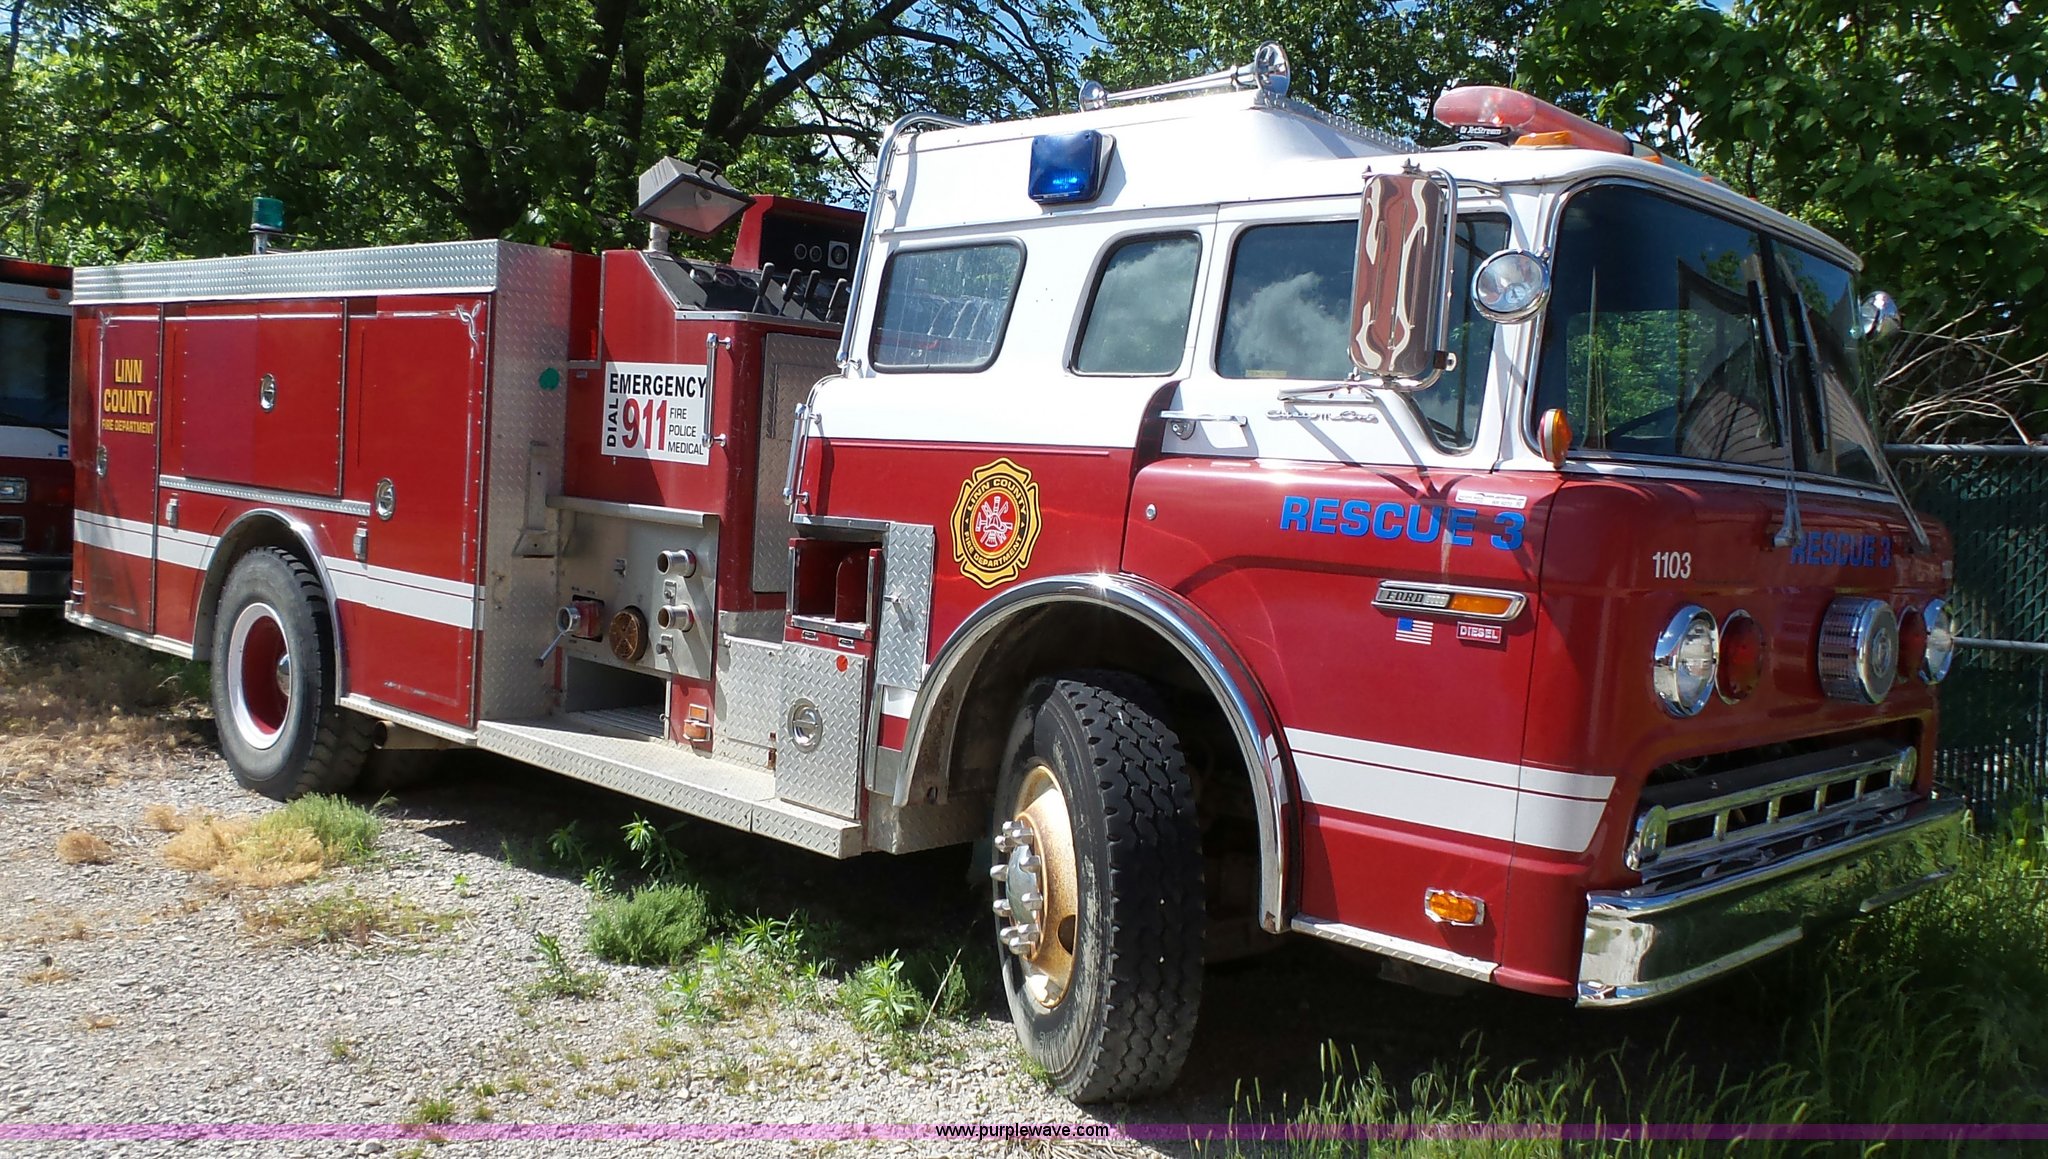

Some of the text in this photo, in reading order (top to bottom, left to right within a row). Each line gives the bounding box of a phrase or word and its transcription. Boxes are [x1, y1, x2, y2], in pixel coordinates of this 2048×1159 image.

[114, 359, 143, 383] LINN
[609, 373, 706, 398] EMERGENCY
[103, 388, 153, 415] COUNTY
[669, 407, 687, 420] FIRE
[102, 419, 154, 434] FIRE DEPARTMENT
[606, 398, 618, 447] DIAL
[621, 398, 667, 450] 911
[668, 424, 697, 438] POLICE
[667, 441, 704, 456] MEDICAL
[967, 479, 1027, 514] LINN COUNTY
[1279, 496, 1526, 550] RESCUE 3
[964, 532, 1022, 567] FIRE DEPARTMENT
[1790, 531, 1892, 568] RESCUE 3
[1652, 551, 1691, 579] 1103
[1386, 590, 1425, 603] FORD
[1460, 625, 1499, 640] DIESEL
